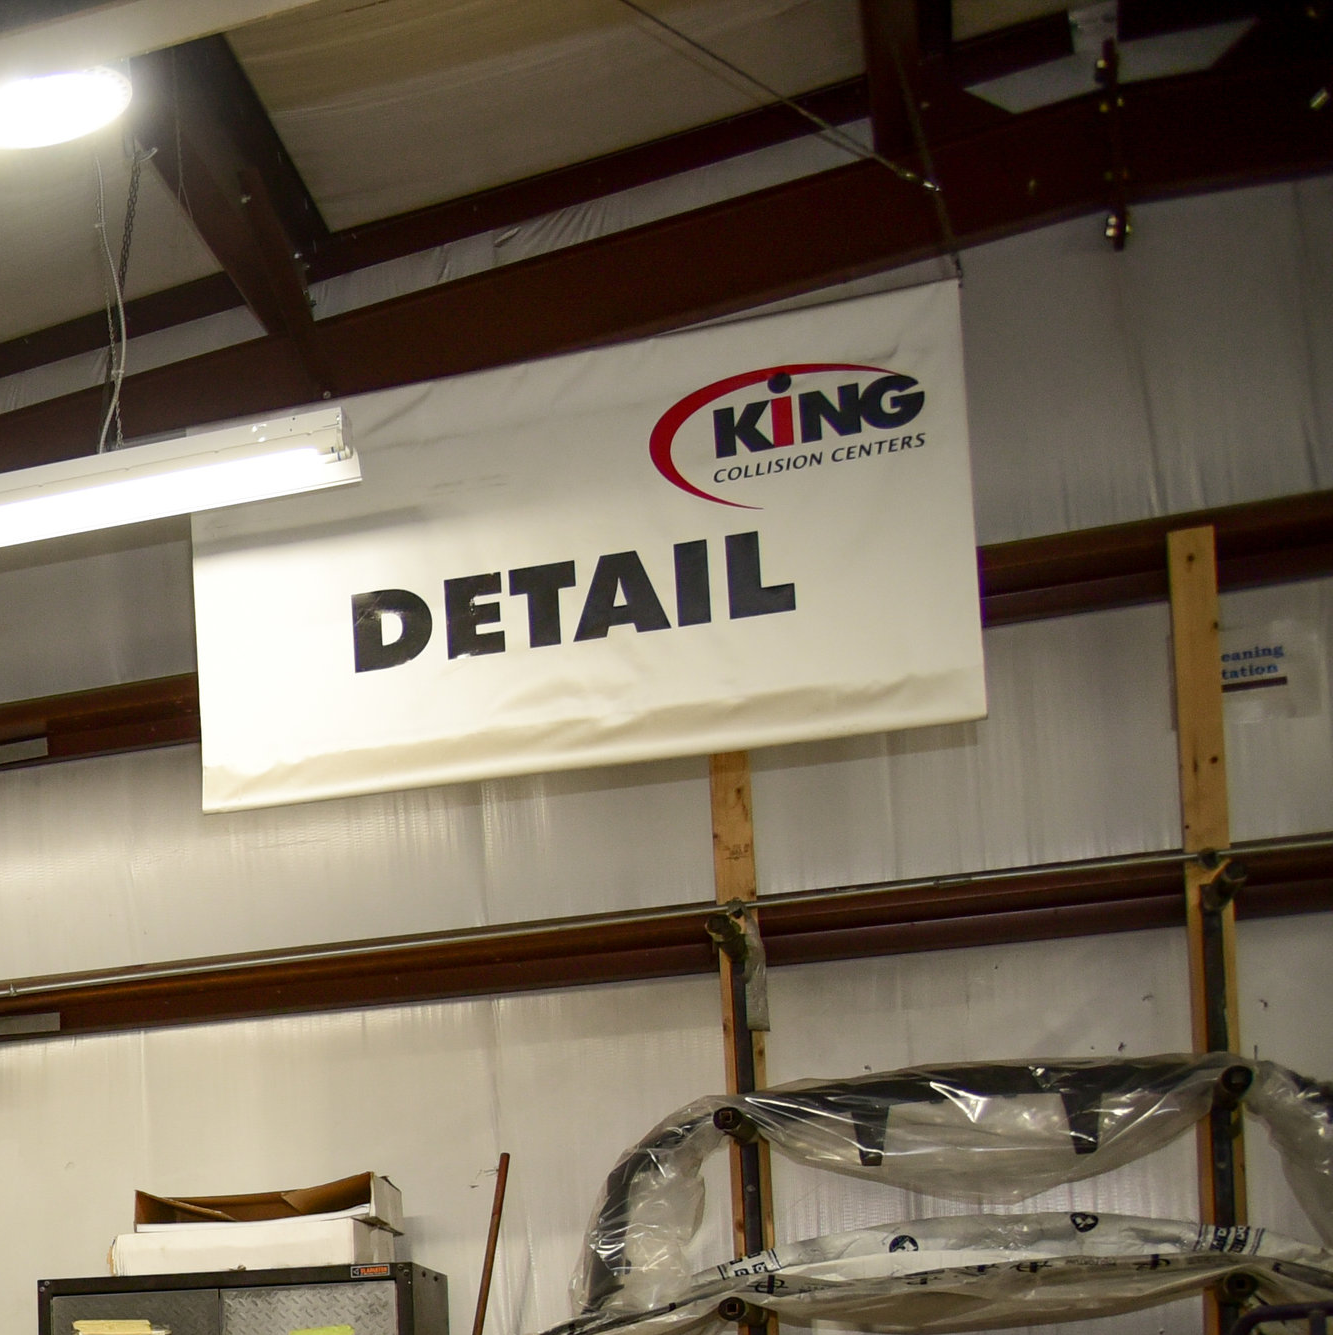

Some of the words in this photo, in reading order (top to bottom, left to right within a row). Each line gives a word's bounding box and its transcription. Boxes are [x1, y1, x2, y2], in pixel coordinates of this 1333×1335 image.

[713, 451, 823, 483] COLLISION
[832, 432, 927, 463] CENTERS
[351, 531, 797, 673] DETAIL
[1221, 645, 1285, 663] eaning
[1221, 663, 1279, 680] tation
